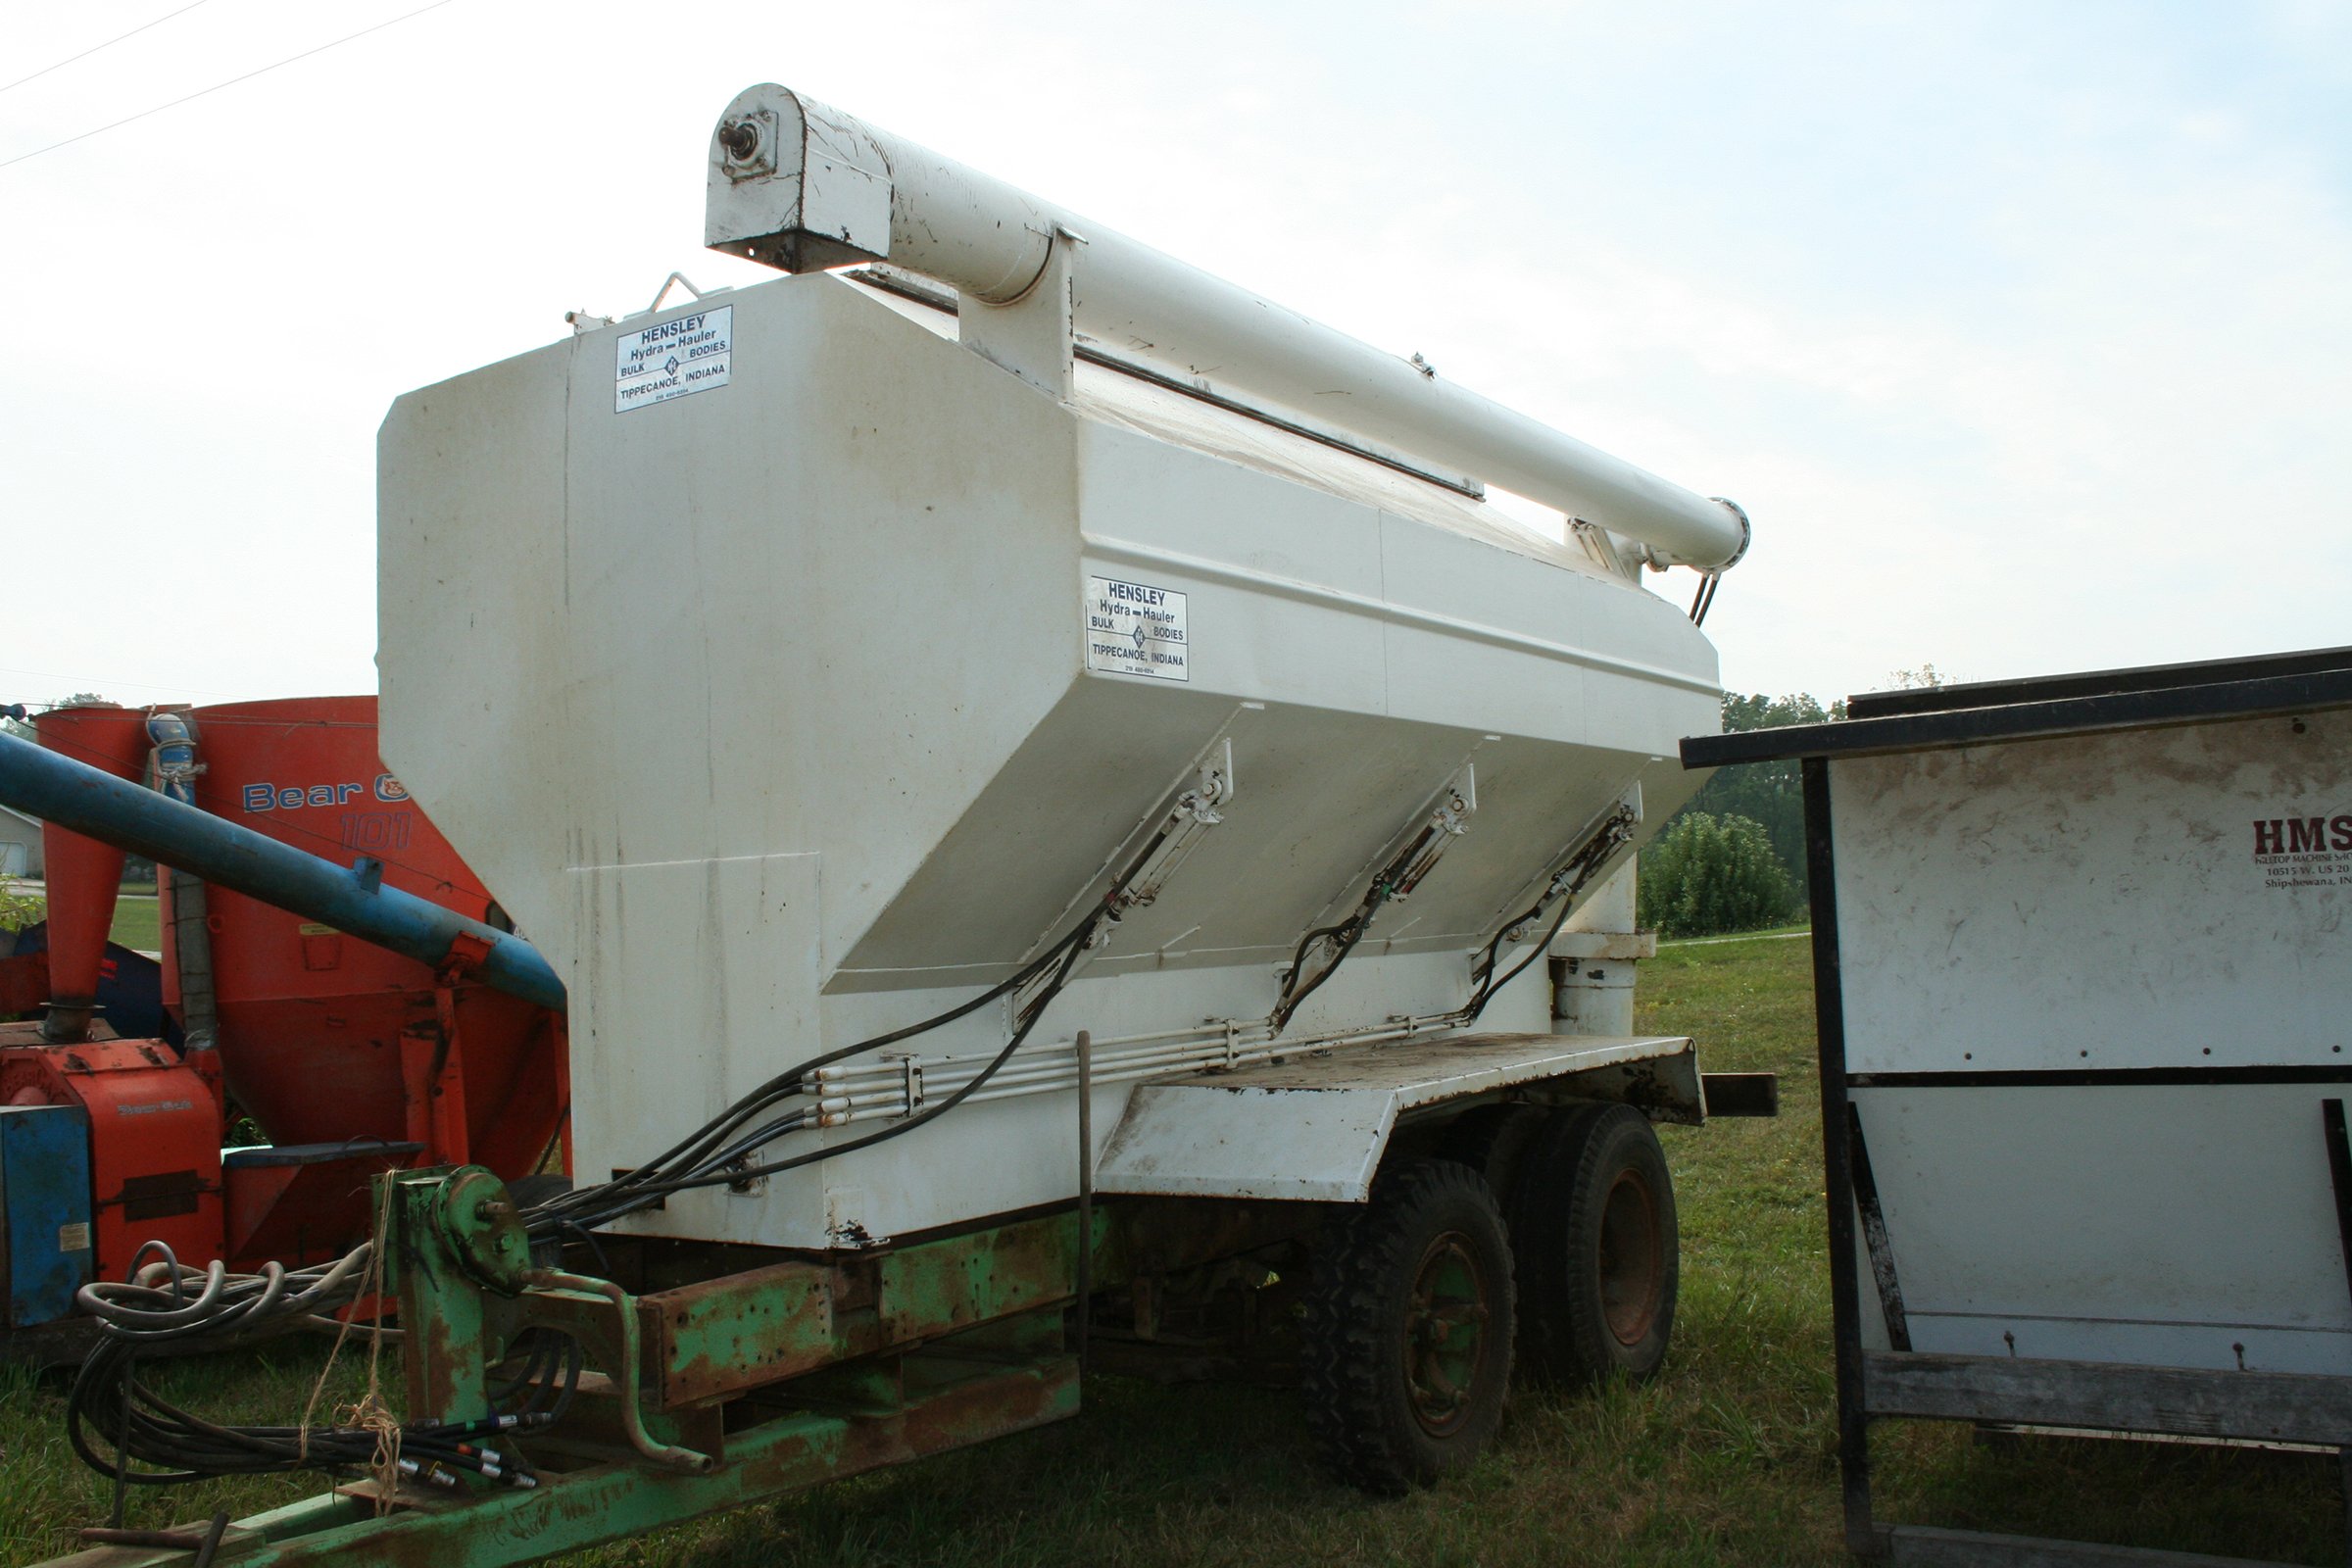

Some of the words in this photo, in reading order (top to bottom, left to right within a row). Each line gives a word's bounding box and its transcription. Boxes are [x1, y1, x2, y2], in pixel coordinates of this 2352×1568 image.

[641, 315, 706, 344] HENSLEY
[620, 363, 645, 377] BULK
[689, 340, 726, 358] BODIES
[620, 376, 681, 400] TIPPECANOE,
[685, 365, 725, 382] INDIANA
[1108, 582, 1165, 607] HENSLEY
[1091, 616, 1114, 629] BULK
[1153, 626, 1184, 640] BODIES
[1093, 644, 1148, 663] TIPPECANOE,
[1151, 653, 1184, 666] INDIANA
[243, 783, 364, 813] Bear
[342, 811, 412, 851] 101
[2253, 814, 2352, 855] HMS
[2267, 866, 2296, 876] 10515
[2318, 864, 2332, 874] US
[2336, 864, 2350, 873] 20
[2292, 854, 2332, 863] MACHINE
